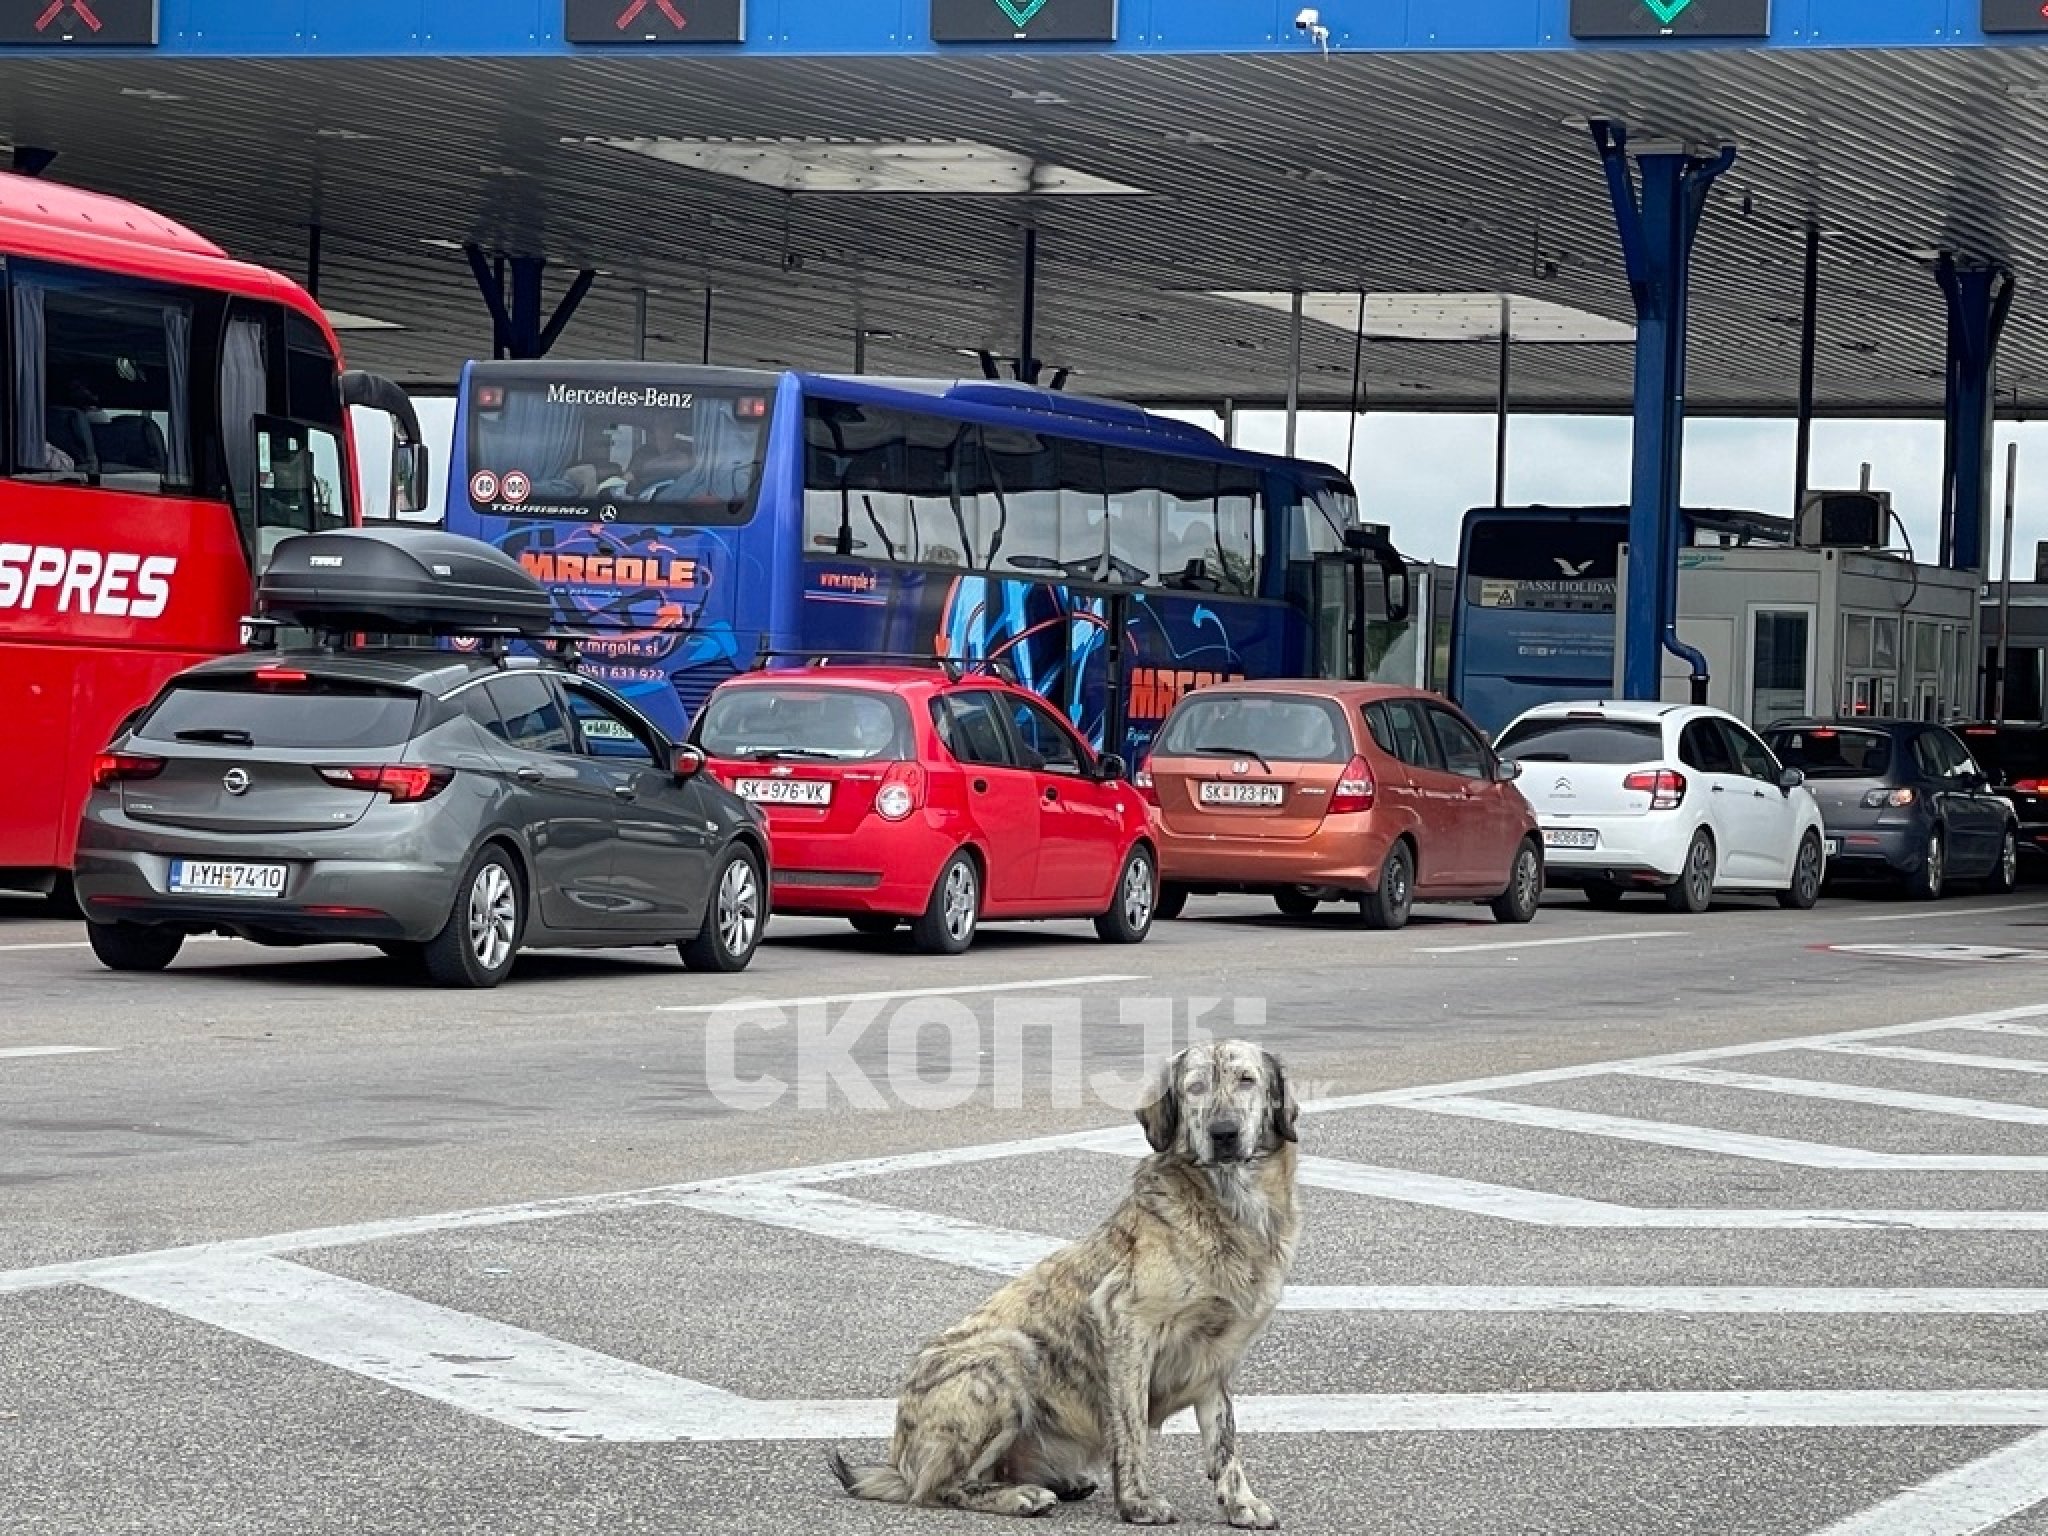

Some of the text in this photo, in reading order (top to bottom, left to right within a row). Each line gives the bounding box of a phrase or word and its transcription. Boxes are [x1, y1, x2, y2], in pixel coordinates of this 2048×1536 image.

[547, 383, 693, 409] Mercedes-Benz
[491, 503, 589, 515] TOURISMO
[519, 551, 696, 589] MRGOLE
